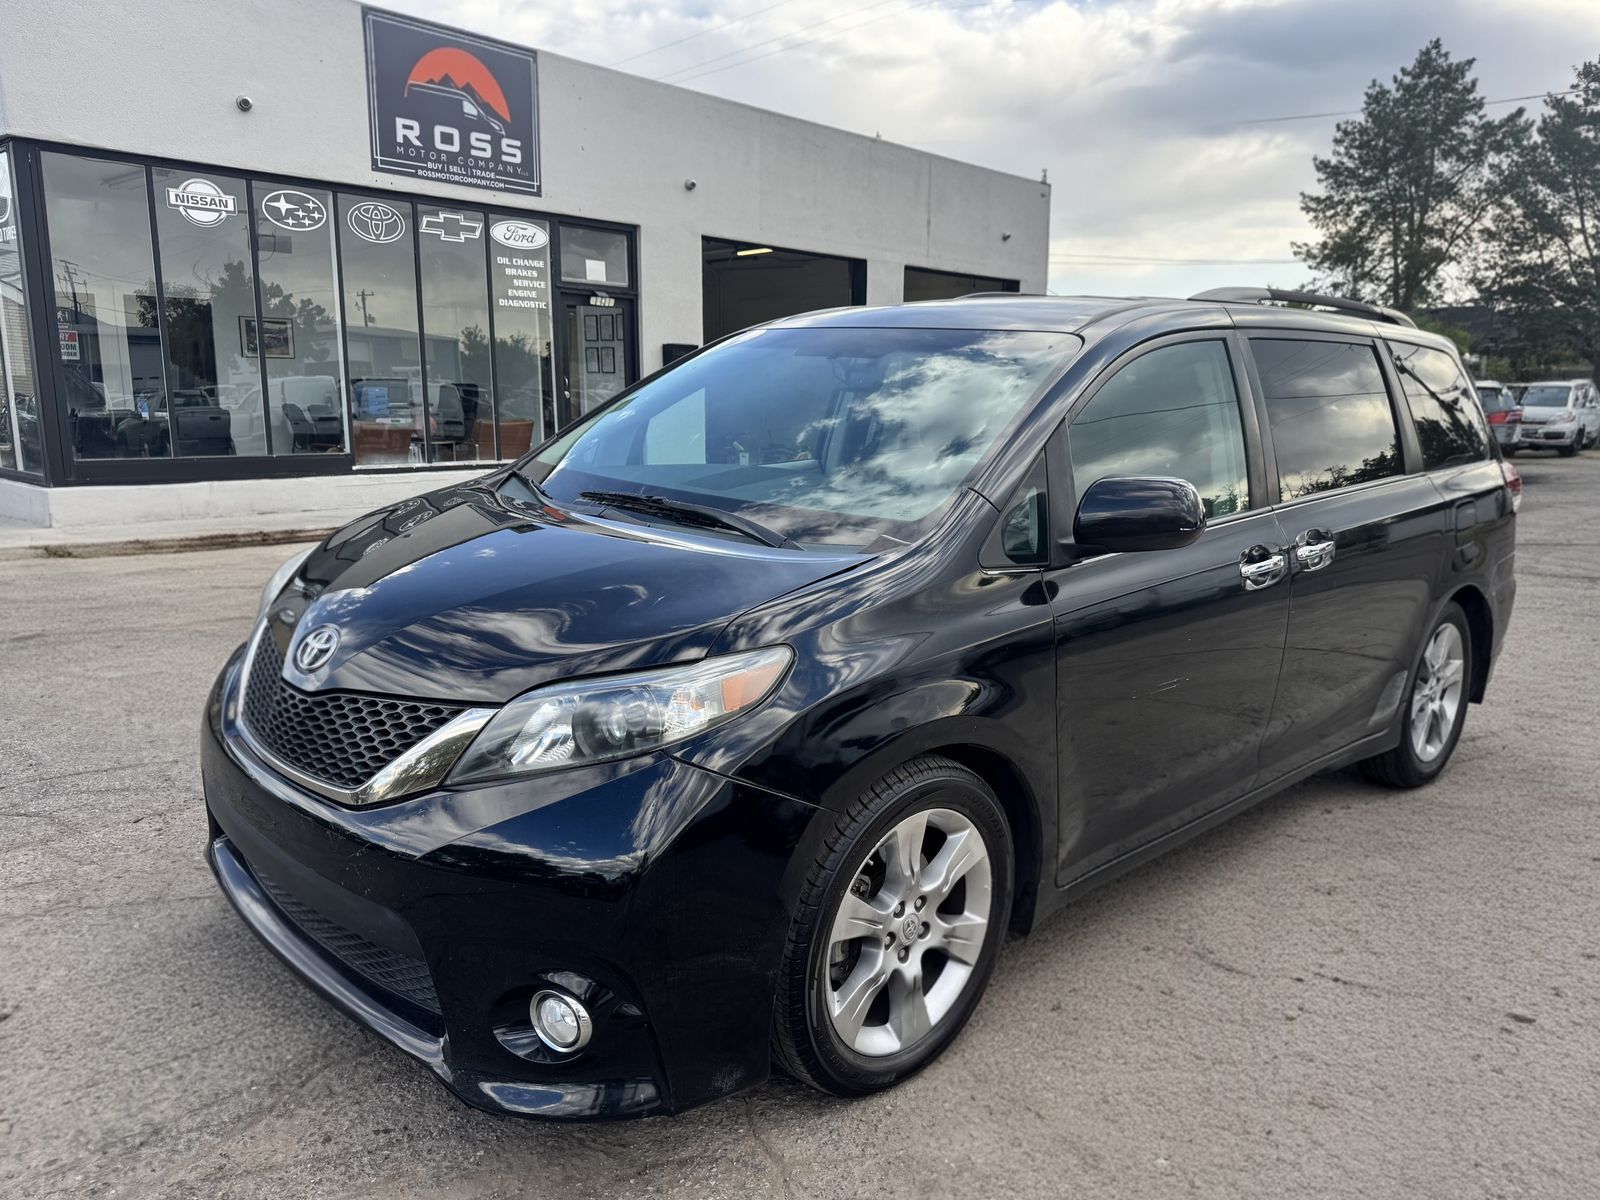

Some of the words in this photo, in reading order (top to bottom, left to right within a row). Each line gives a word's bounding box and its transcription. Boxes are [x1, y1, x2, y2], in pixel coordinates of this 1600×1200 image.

[395, 117, 522, 164] ROSS
[396, 146, 447, 161] MOTOR
[457, 156, 522, 174] COMPANY
[427, 161, 442, 170] BUY
[449, 165, 467, 174] SELL
[472, 169, 496, 179] TRADE
[417, 169, 505, 189] ROSSMOTORCOMPANY.COM
[174, 193, 229, 209] NISSAN
[503, 224, 537, 244] Ford
[496, 256, 511, 265] OIL
[512, 258, 545, 268] CHANGE
[505, 268, 538, 277] BRAKES
[513, 279, 546, 289] SERVICE
[508, 289, 537, 298] ENGINE
[499, 299, 547, 309] DIAGNOSTIC
